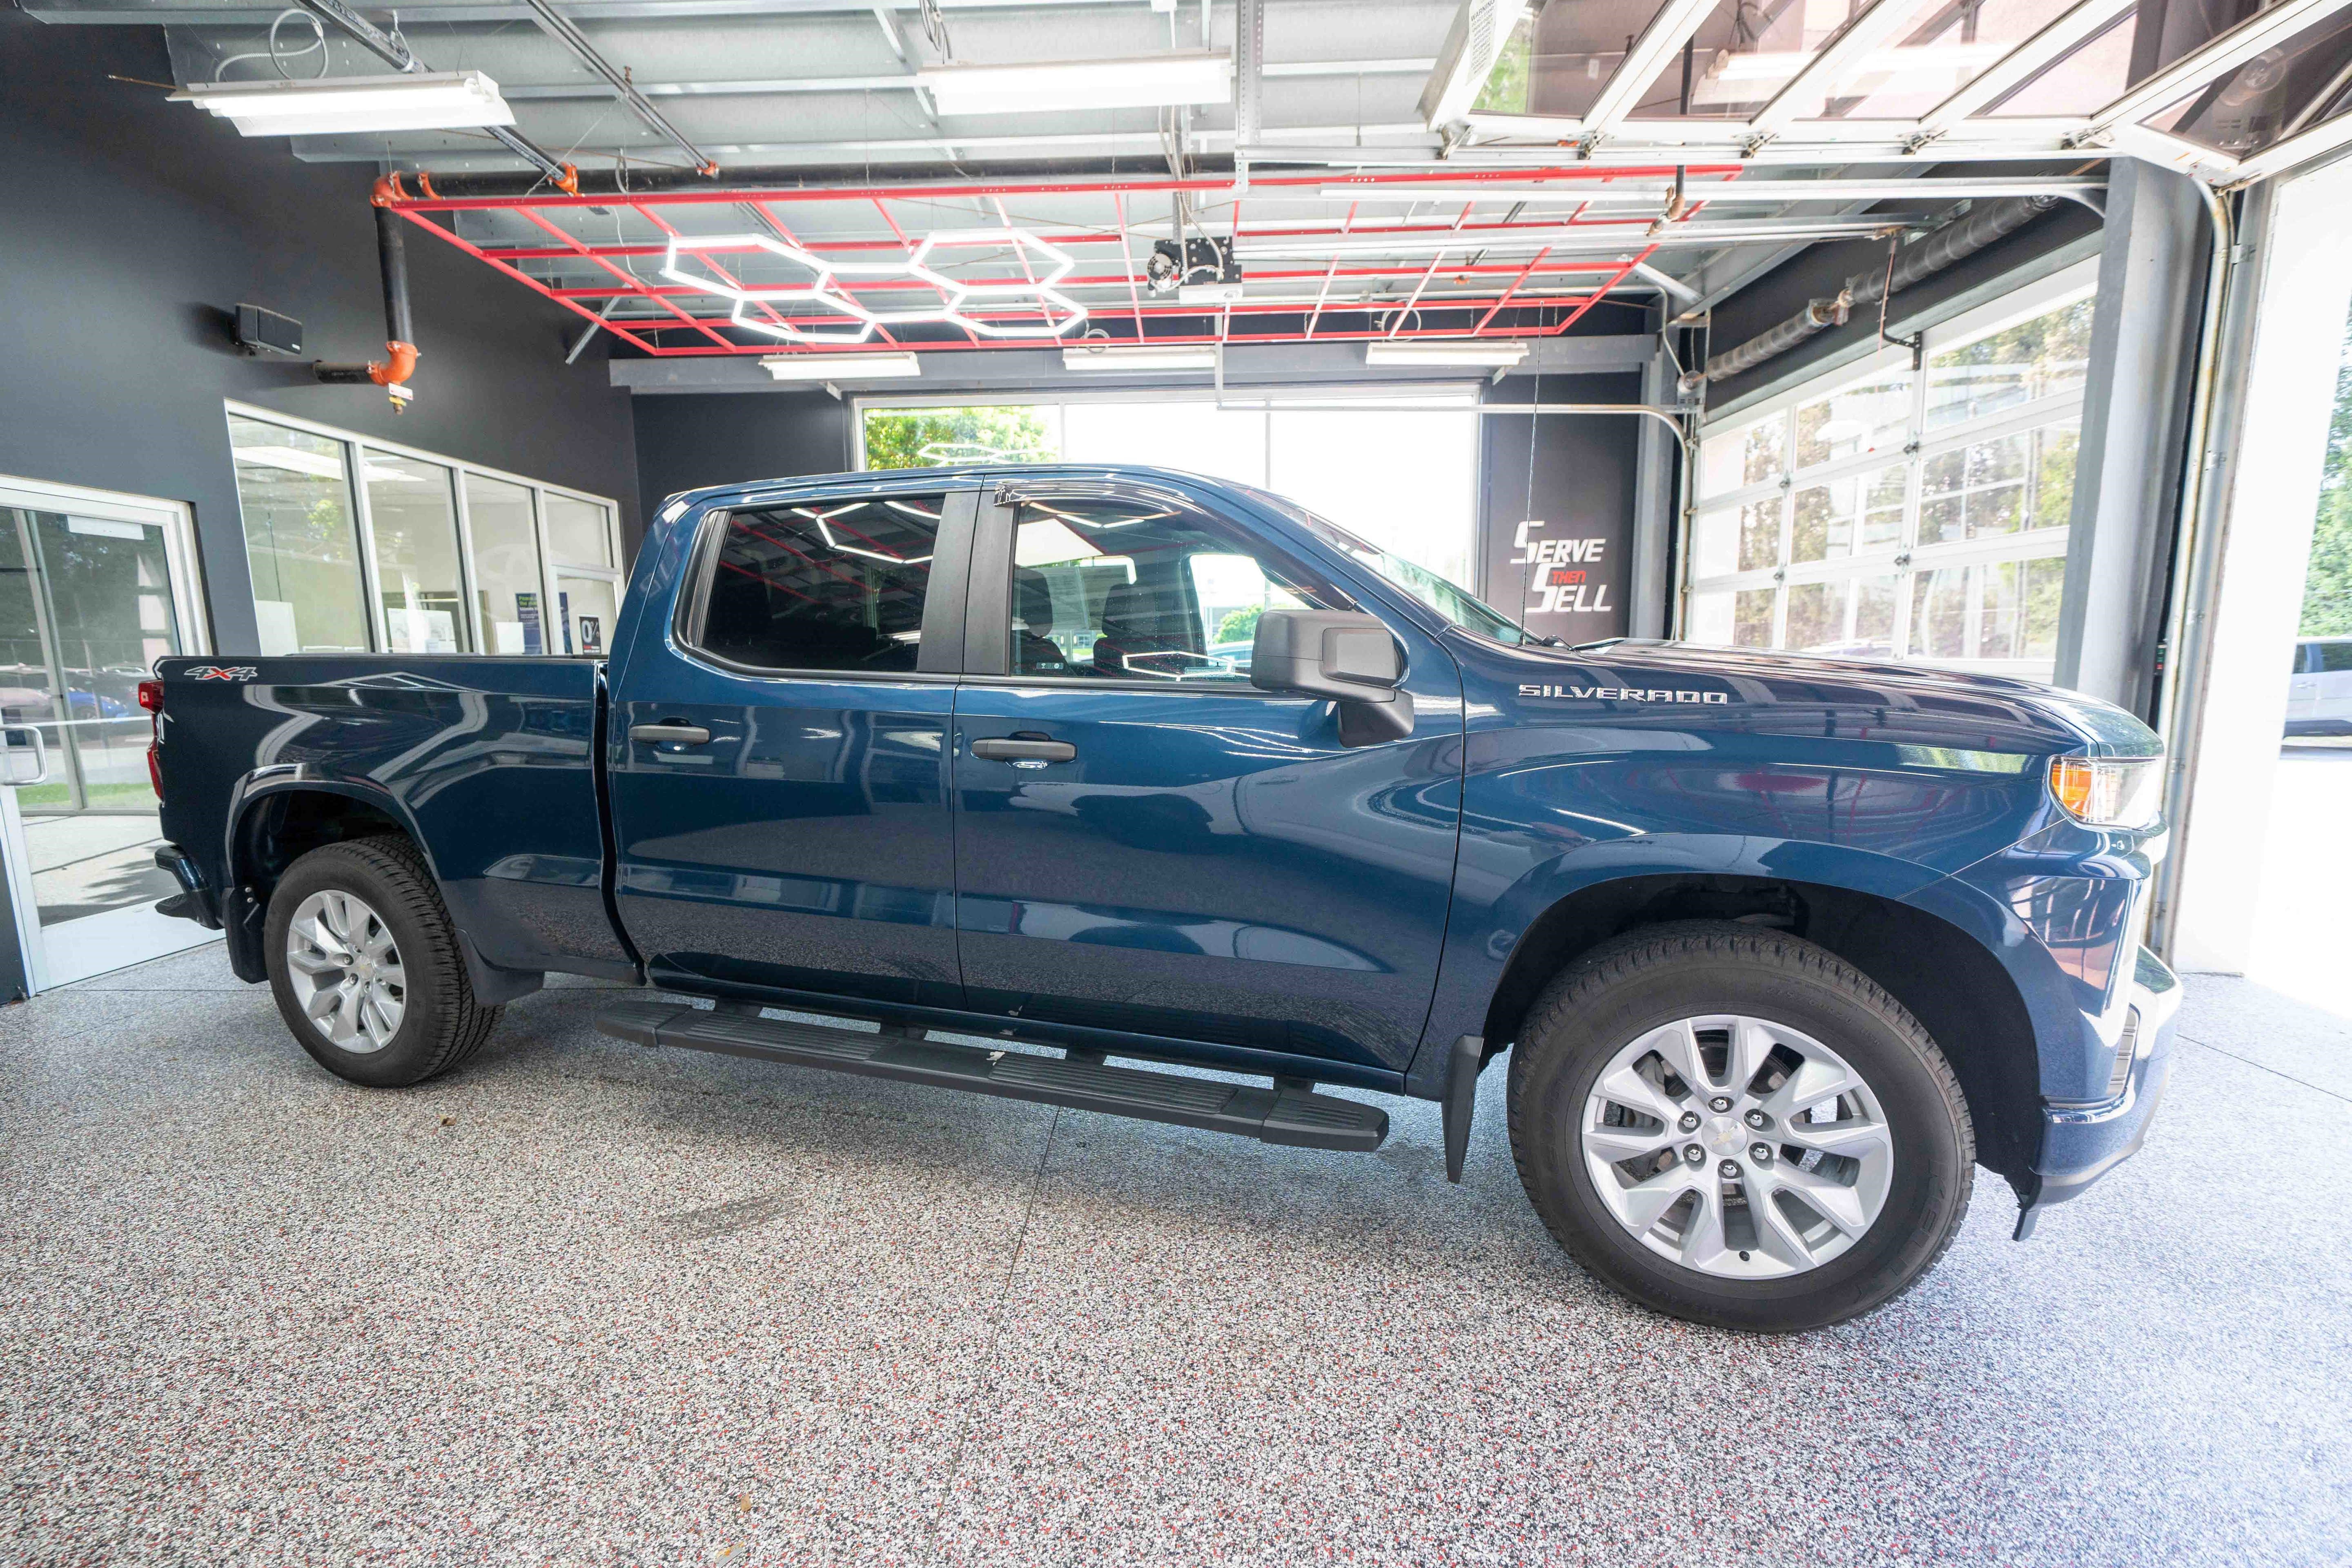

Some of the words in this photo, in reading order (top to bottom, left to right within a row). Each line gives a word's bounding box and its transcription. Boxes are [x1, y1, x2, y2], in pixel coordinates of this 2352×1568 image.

[1510, 521, 1606, 564] SERVE
[1525, 562, 1612, 613] SELL
[1552, 570, 1586, 584] THEN
[581, 620, 600, 643] 0%
[1519, 684, 1728, 705] SILVERADO
